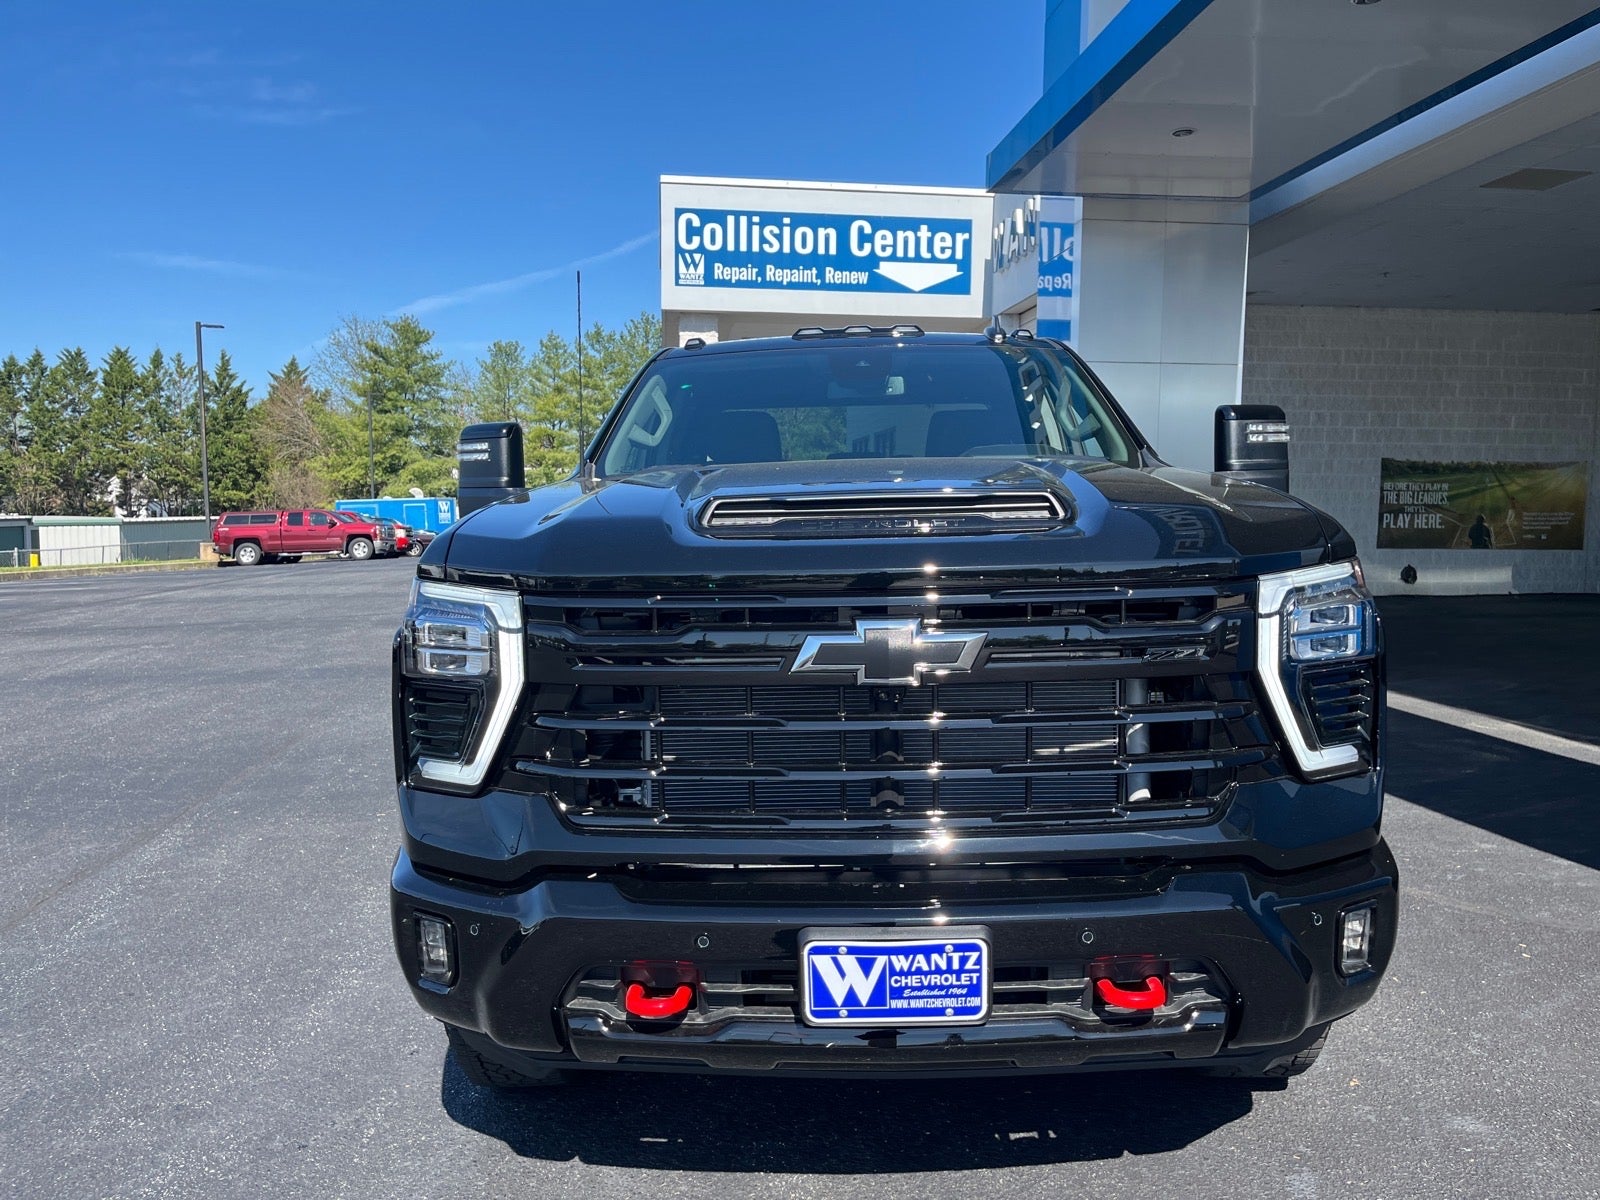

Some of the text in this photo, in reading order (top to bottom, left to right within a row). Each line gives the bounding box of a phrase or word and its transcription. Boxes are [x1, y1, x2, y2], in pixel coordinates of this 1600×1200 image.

[677, 211, 970, 260] Collision Center
[679, 273, 704, 281] WANTZ
[713, 262, 869, 287] Repair, Repaint, Renew
[1383, 490, 1398, 505] THE
[1400, 491, 1413, 505] BIG
[1382, 513, 1445, 529] PLAY HERE.
[890, 951, 981, 972] WANTZ
[811, 955, 888, 1008] W
[890, 973, 980, 988] CHEVROLET
[903, 987, 968, 997] Established 1964
[890, 996, 981, 1009] WWW.WANTZCHEVROLET.COM
